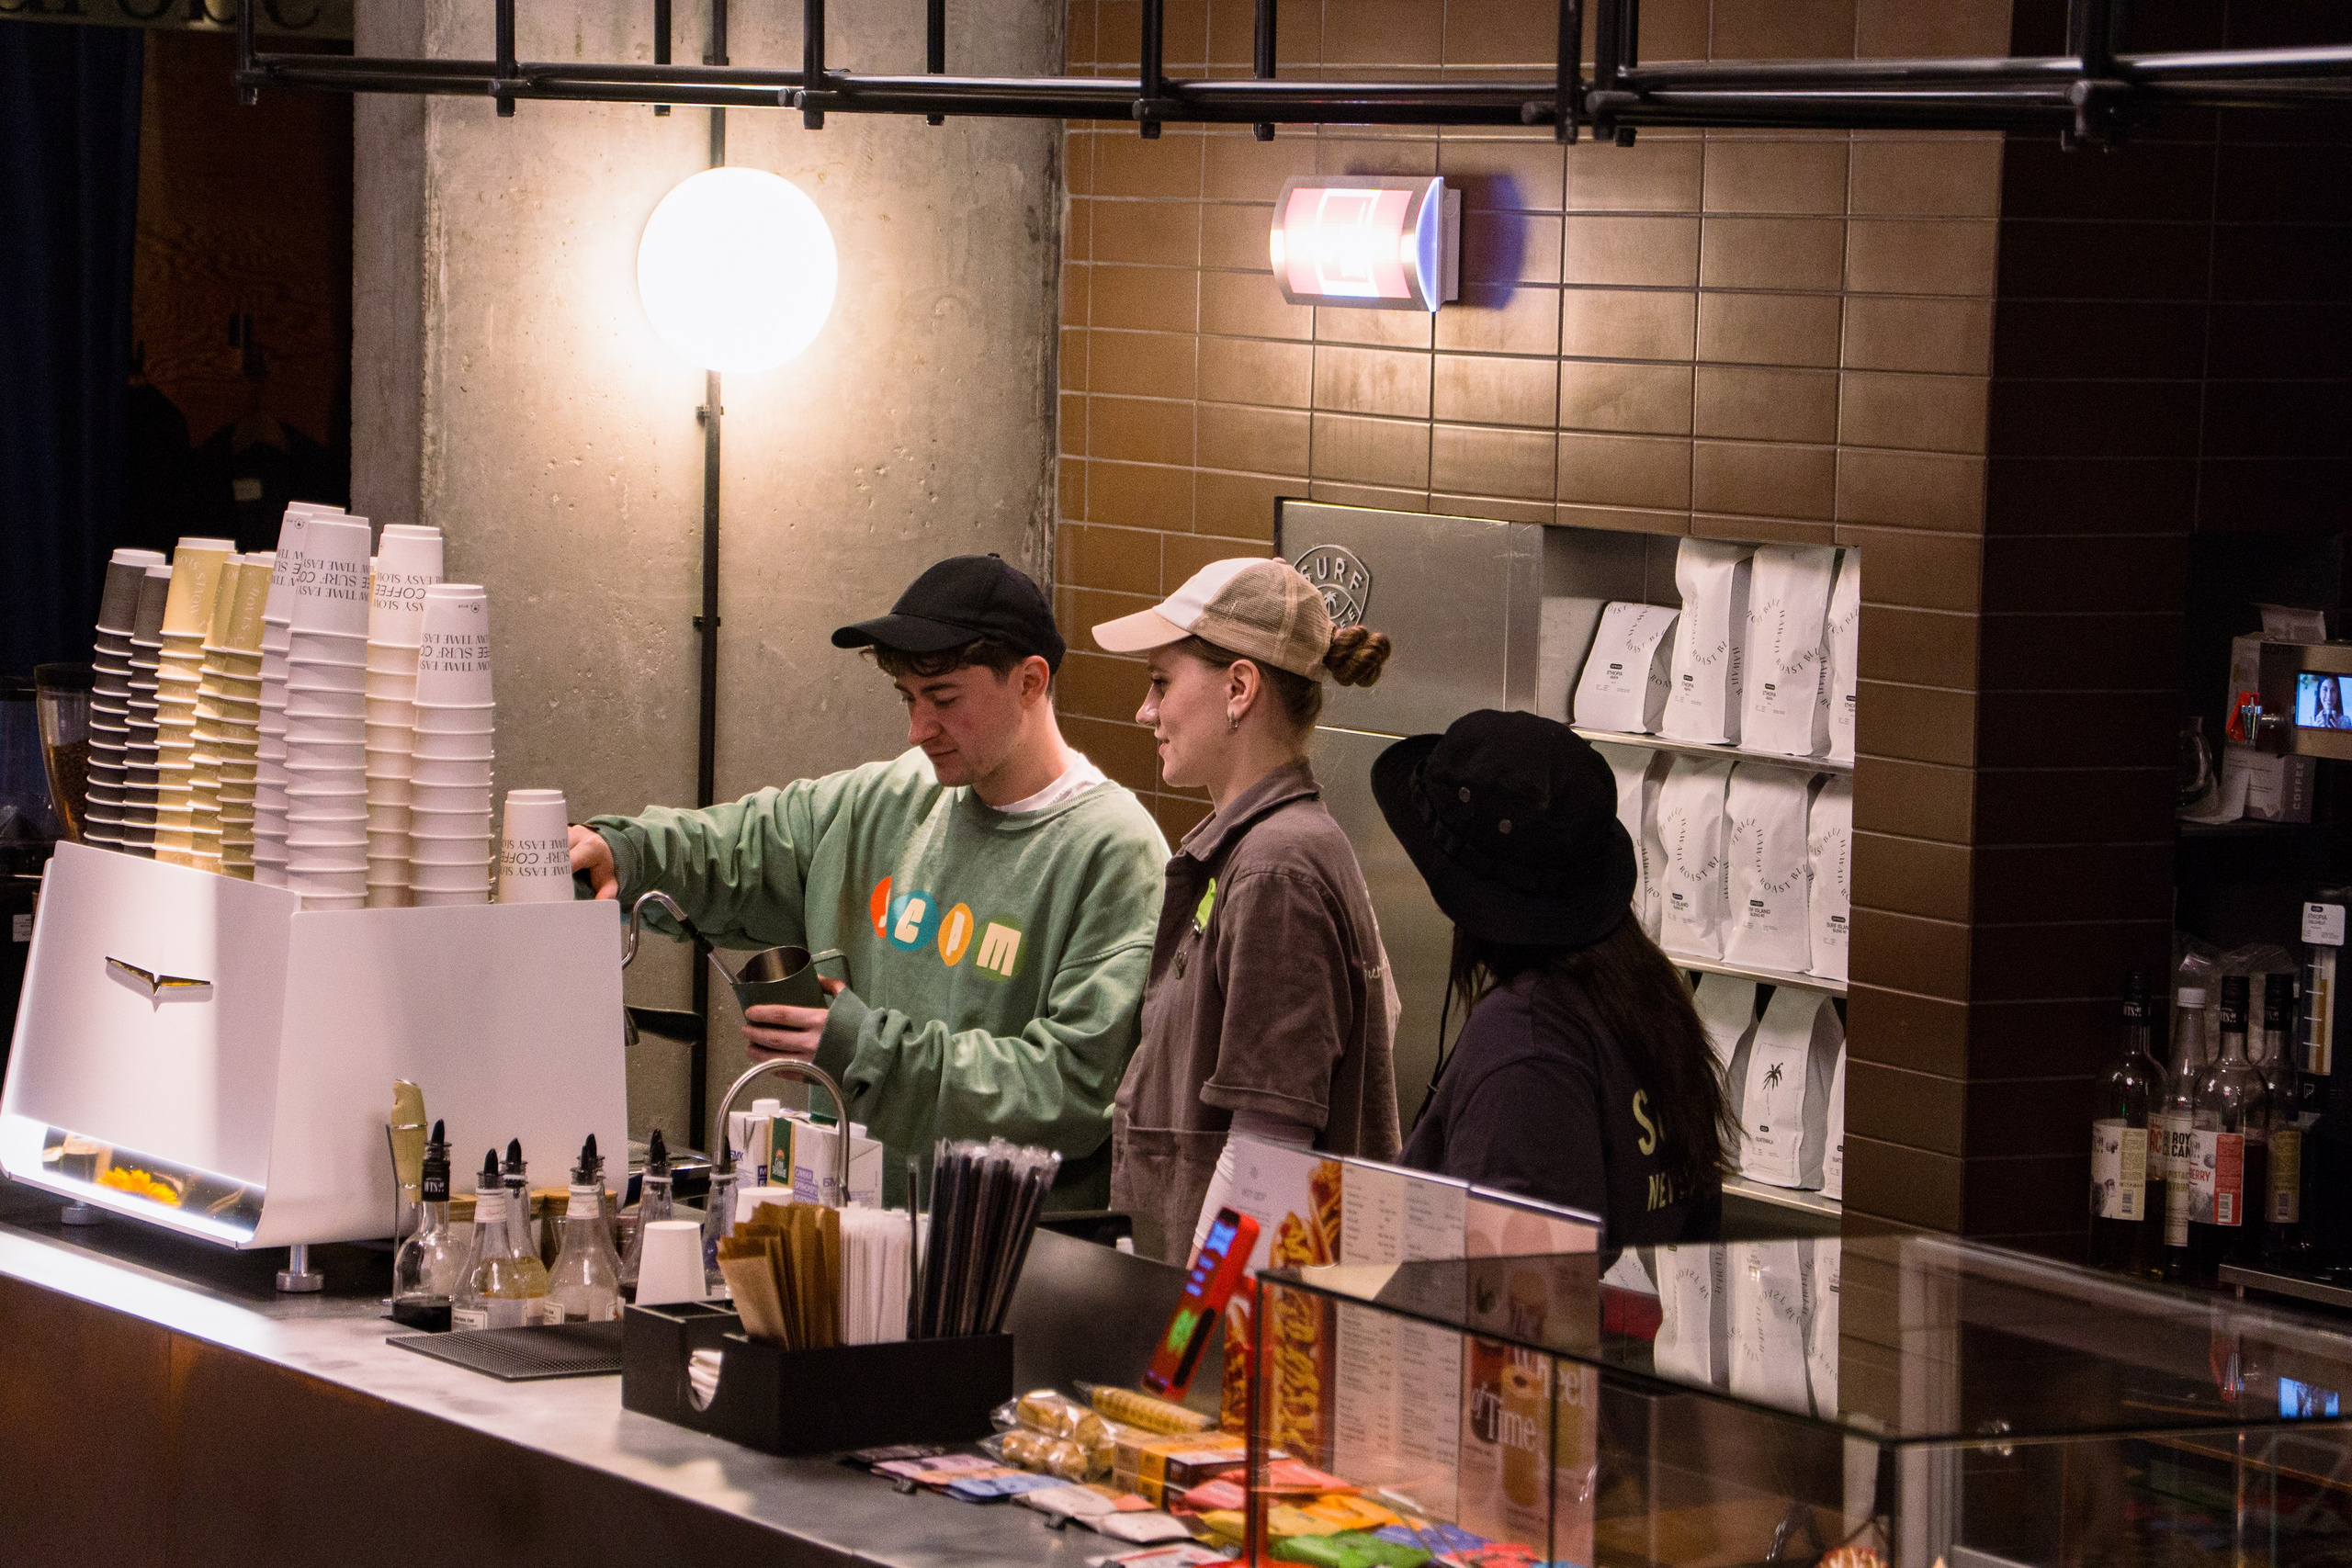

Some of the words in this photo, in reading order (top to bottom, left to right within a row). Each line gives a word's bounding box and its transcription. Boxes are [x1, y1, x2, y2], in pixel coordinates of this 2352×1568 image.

[328, 561, 357, 572] TIME
[320, 573, 356, 586] SURF
[402, 574, 432, 584] EASY
[1300, 556, 1364, 592] SURF
[296, 586, 321, 595] EASY
[325, 589, 356, 600] TIME
[374, 583, 426, 600] COFFEE
[443, 635, 472, 644] TIME
[436, 647, 472, 659] SURF
[1691, 649, 1717, 666] ROAST
[441, 661, 473, 671] TIME
[1731, 646, 1742, 686] HAWAII
[1775, 658, 1804, 675] ROAST
[2292, 761, 2304, 810] COFFEE
[1736, 818, 1757, 834] BLUE
[516, 840, 545, 849] EASY
[548, 838, 568, 849] TIME
[1676, 818, 1687, 862] HAWAII
[544, 851, 569, 863] SURF
[1756, 829, 1764, 874] HAWAII
[1837, 839, 1847, 885] HAWAII
[515, 866, 547, 876] EASY
[551, 863, 571, 875] TIME
[1679, 865, 1708, 882] ROAST
[1759, 877, 1792, 894] ROAST
[2172, 1132, 2191, 1145] ROY
[2171, 1145, 2191, 1158] CAN
[1646, 1171, 1673, 1212] NE
[1487, 1391, 1537, 1452] Time
